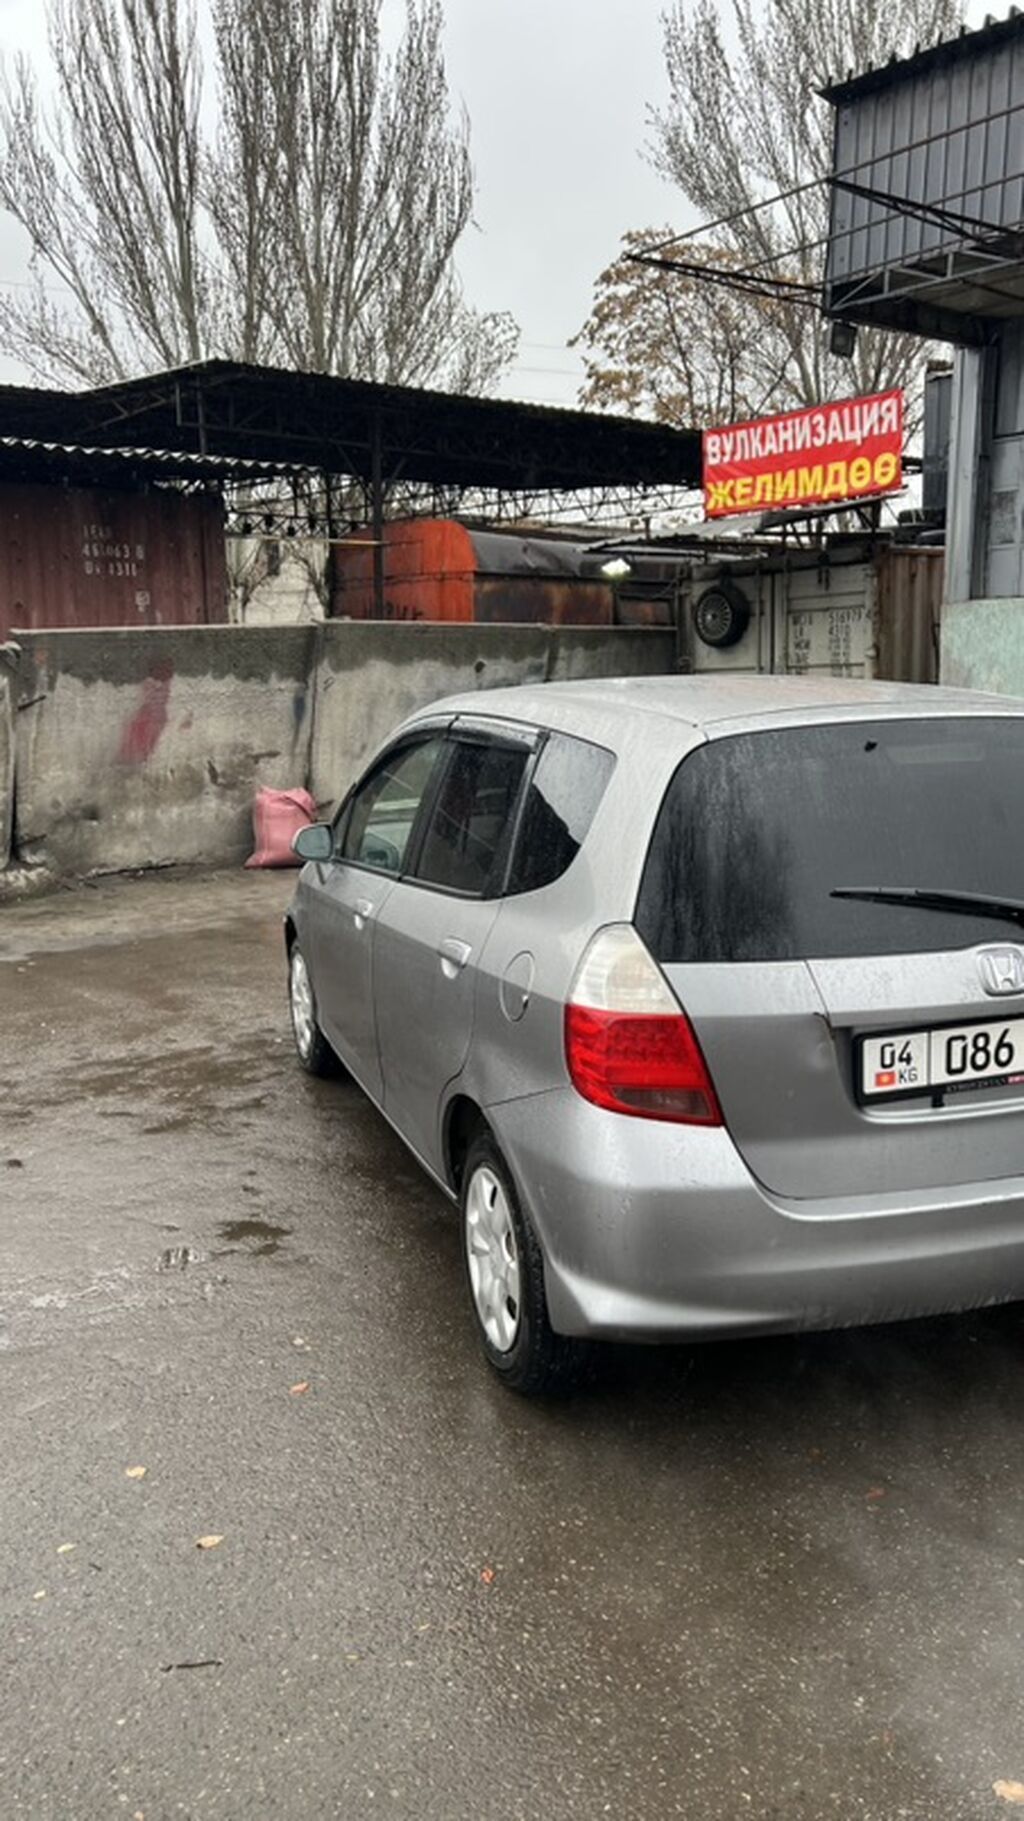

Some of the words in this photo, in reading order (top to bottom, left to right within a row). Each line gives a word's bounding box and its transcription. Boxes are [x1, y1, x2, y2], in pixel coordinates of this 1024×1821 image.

[706, 398, 898, 465] ВУЛКАНИЗАЦИЯ
[706, 452, 898, 510] ЖЕЛИМДӨӨ
[880, 1040, 913, 1069] 04
[946, 1028, 1014, 1076] 086
[898, 1068, 918, 1084] KG
